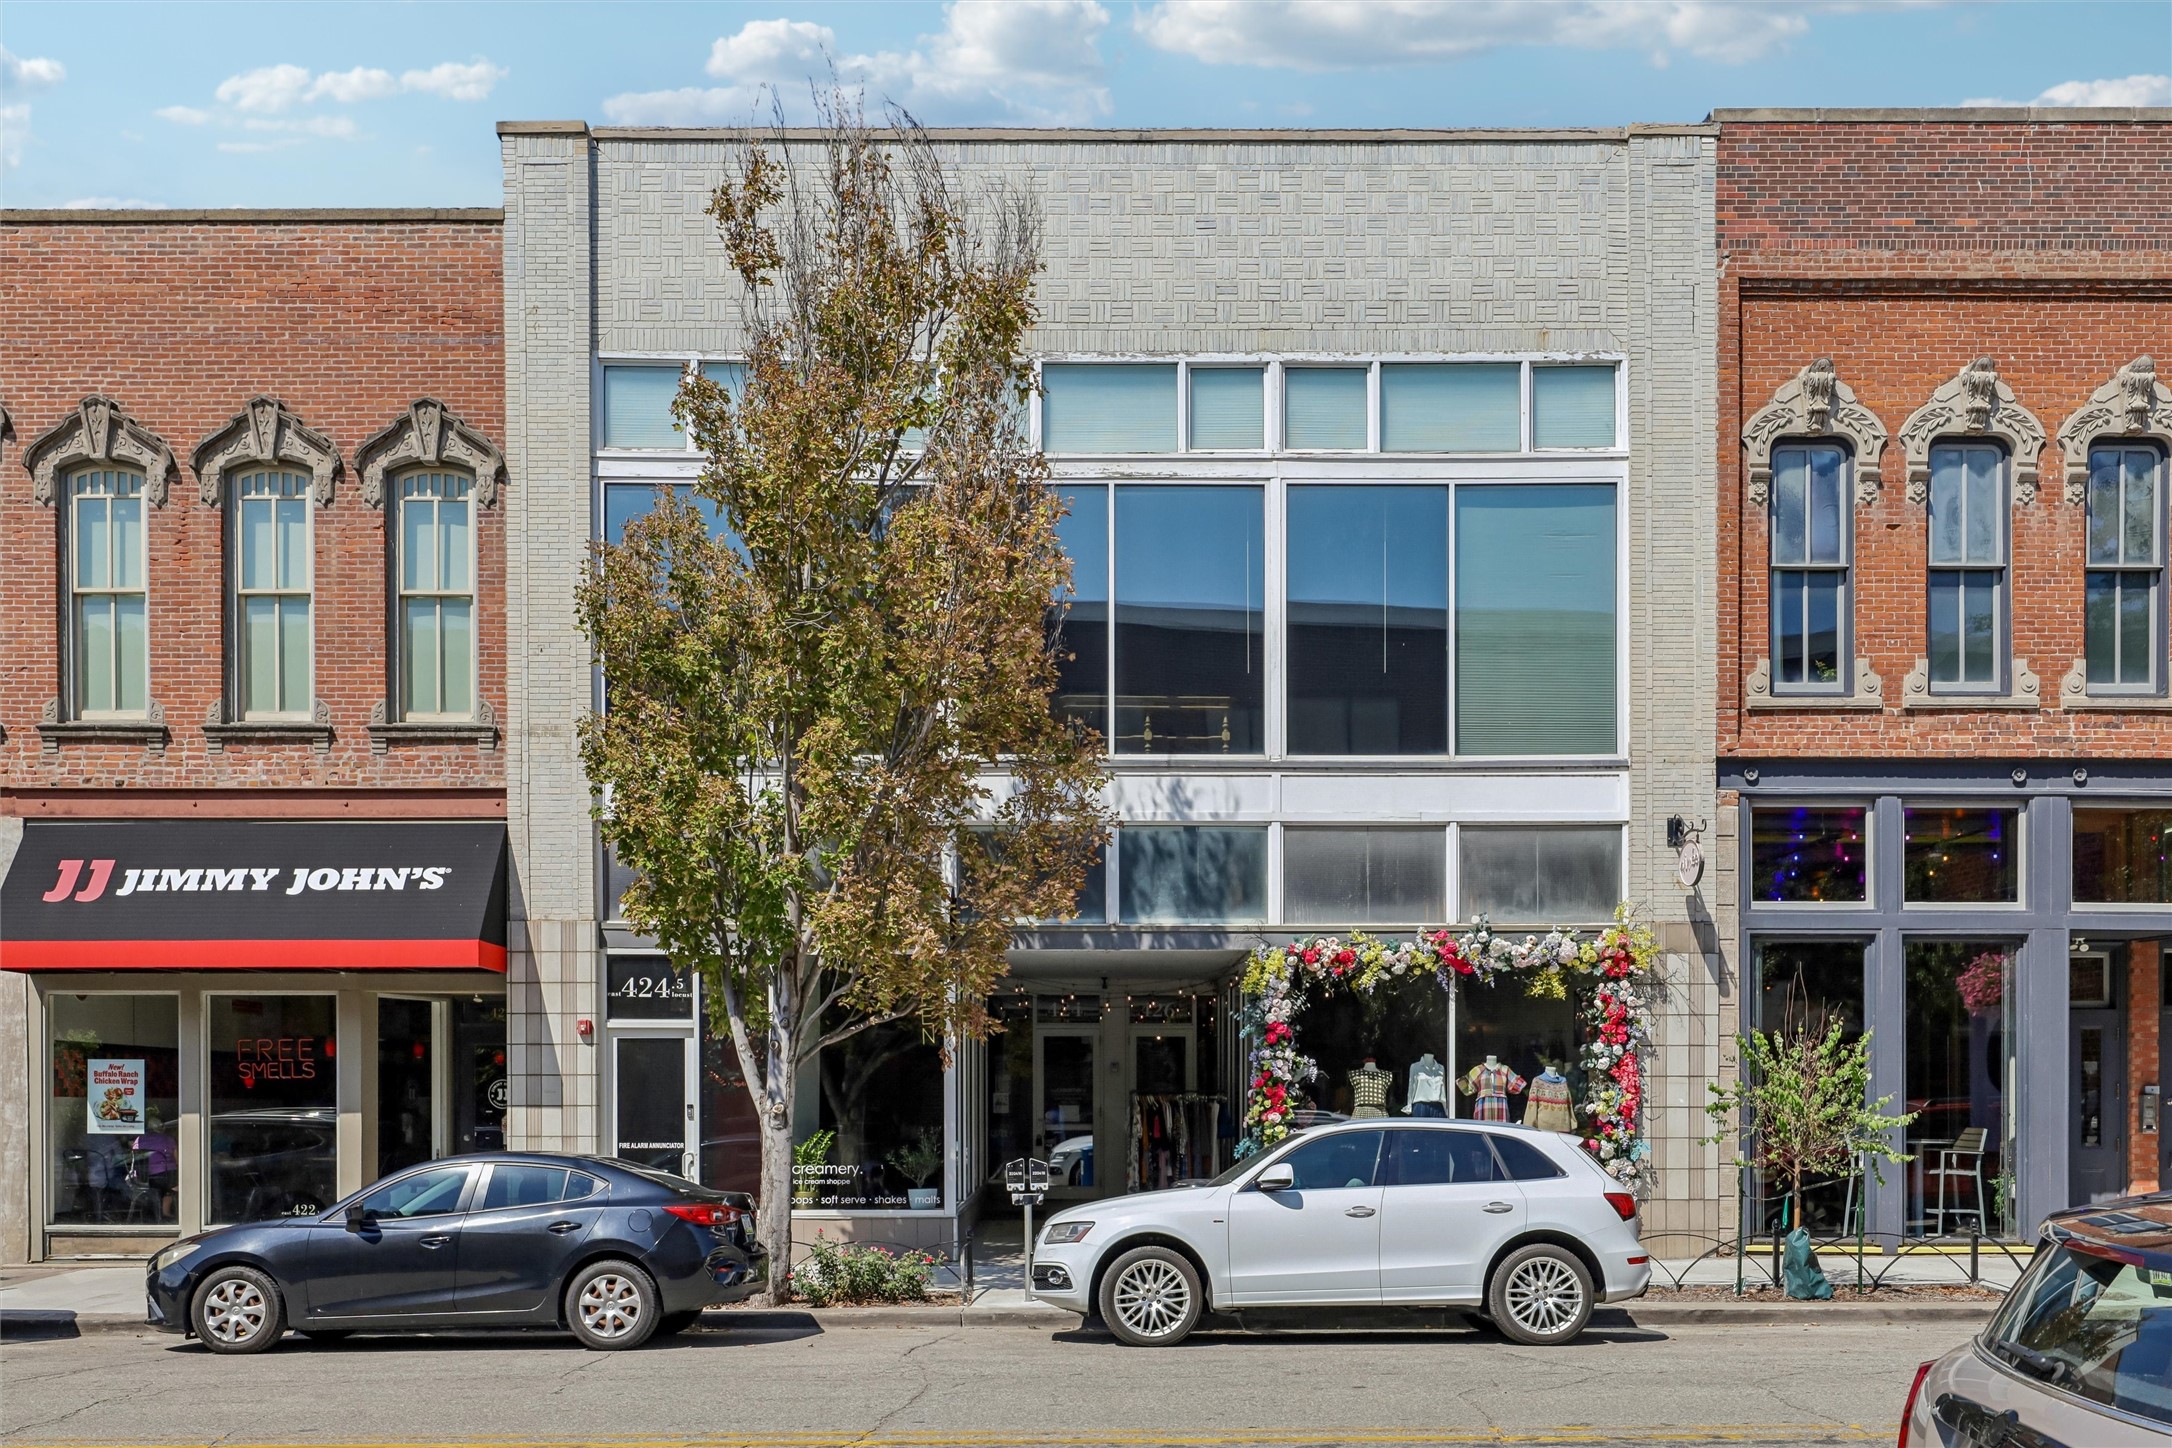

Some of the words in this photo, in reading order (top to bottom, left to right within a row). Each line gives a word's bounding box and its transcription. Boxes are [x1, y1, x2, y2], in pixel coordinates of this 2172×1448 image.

[42, 859, 116, 902] JJ
[115, 868, 280, 896] JIMMY
[286, 867, 447, 895] JOHN'S
[237, 1038, 315, 1061] FREE
[238, 1062, 316, 1080] SMELLS
[94, 1077, 120, 1085] Chicken
[120, 1077, 139, 1086] Wrap
[791, 1164, 863, 1177] creamery.
[826, 1178, 851, 1186] shoppe
[790, 1196, 813, 1206] oops
[820, 1195, 838, 1206] soft
[840, 1196, 867, 1205] serve
[874, 1195, 907, 1205] shakes
[914, 1195, 941, 1205] malts
[292, 1204, 316, 1216] 422
